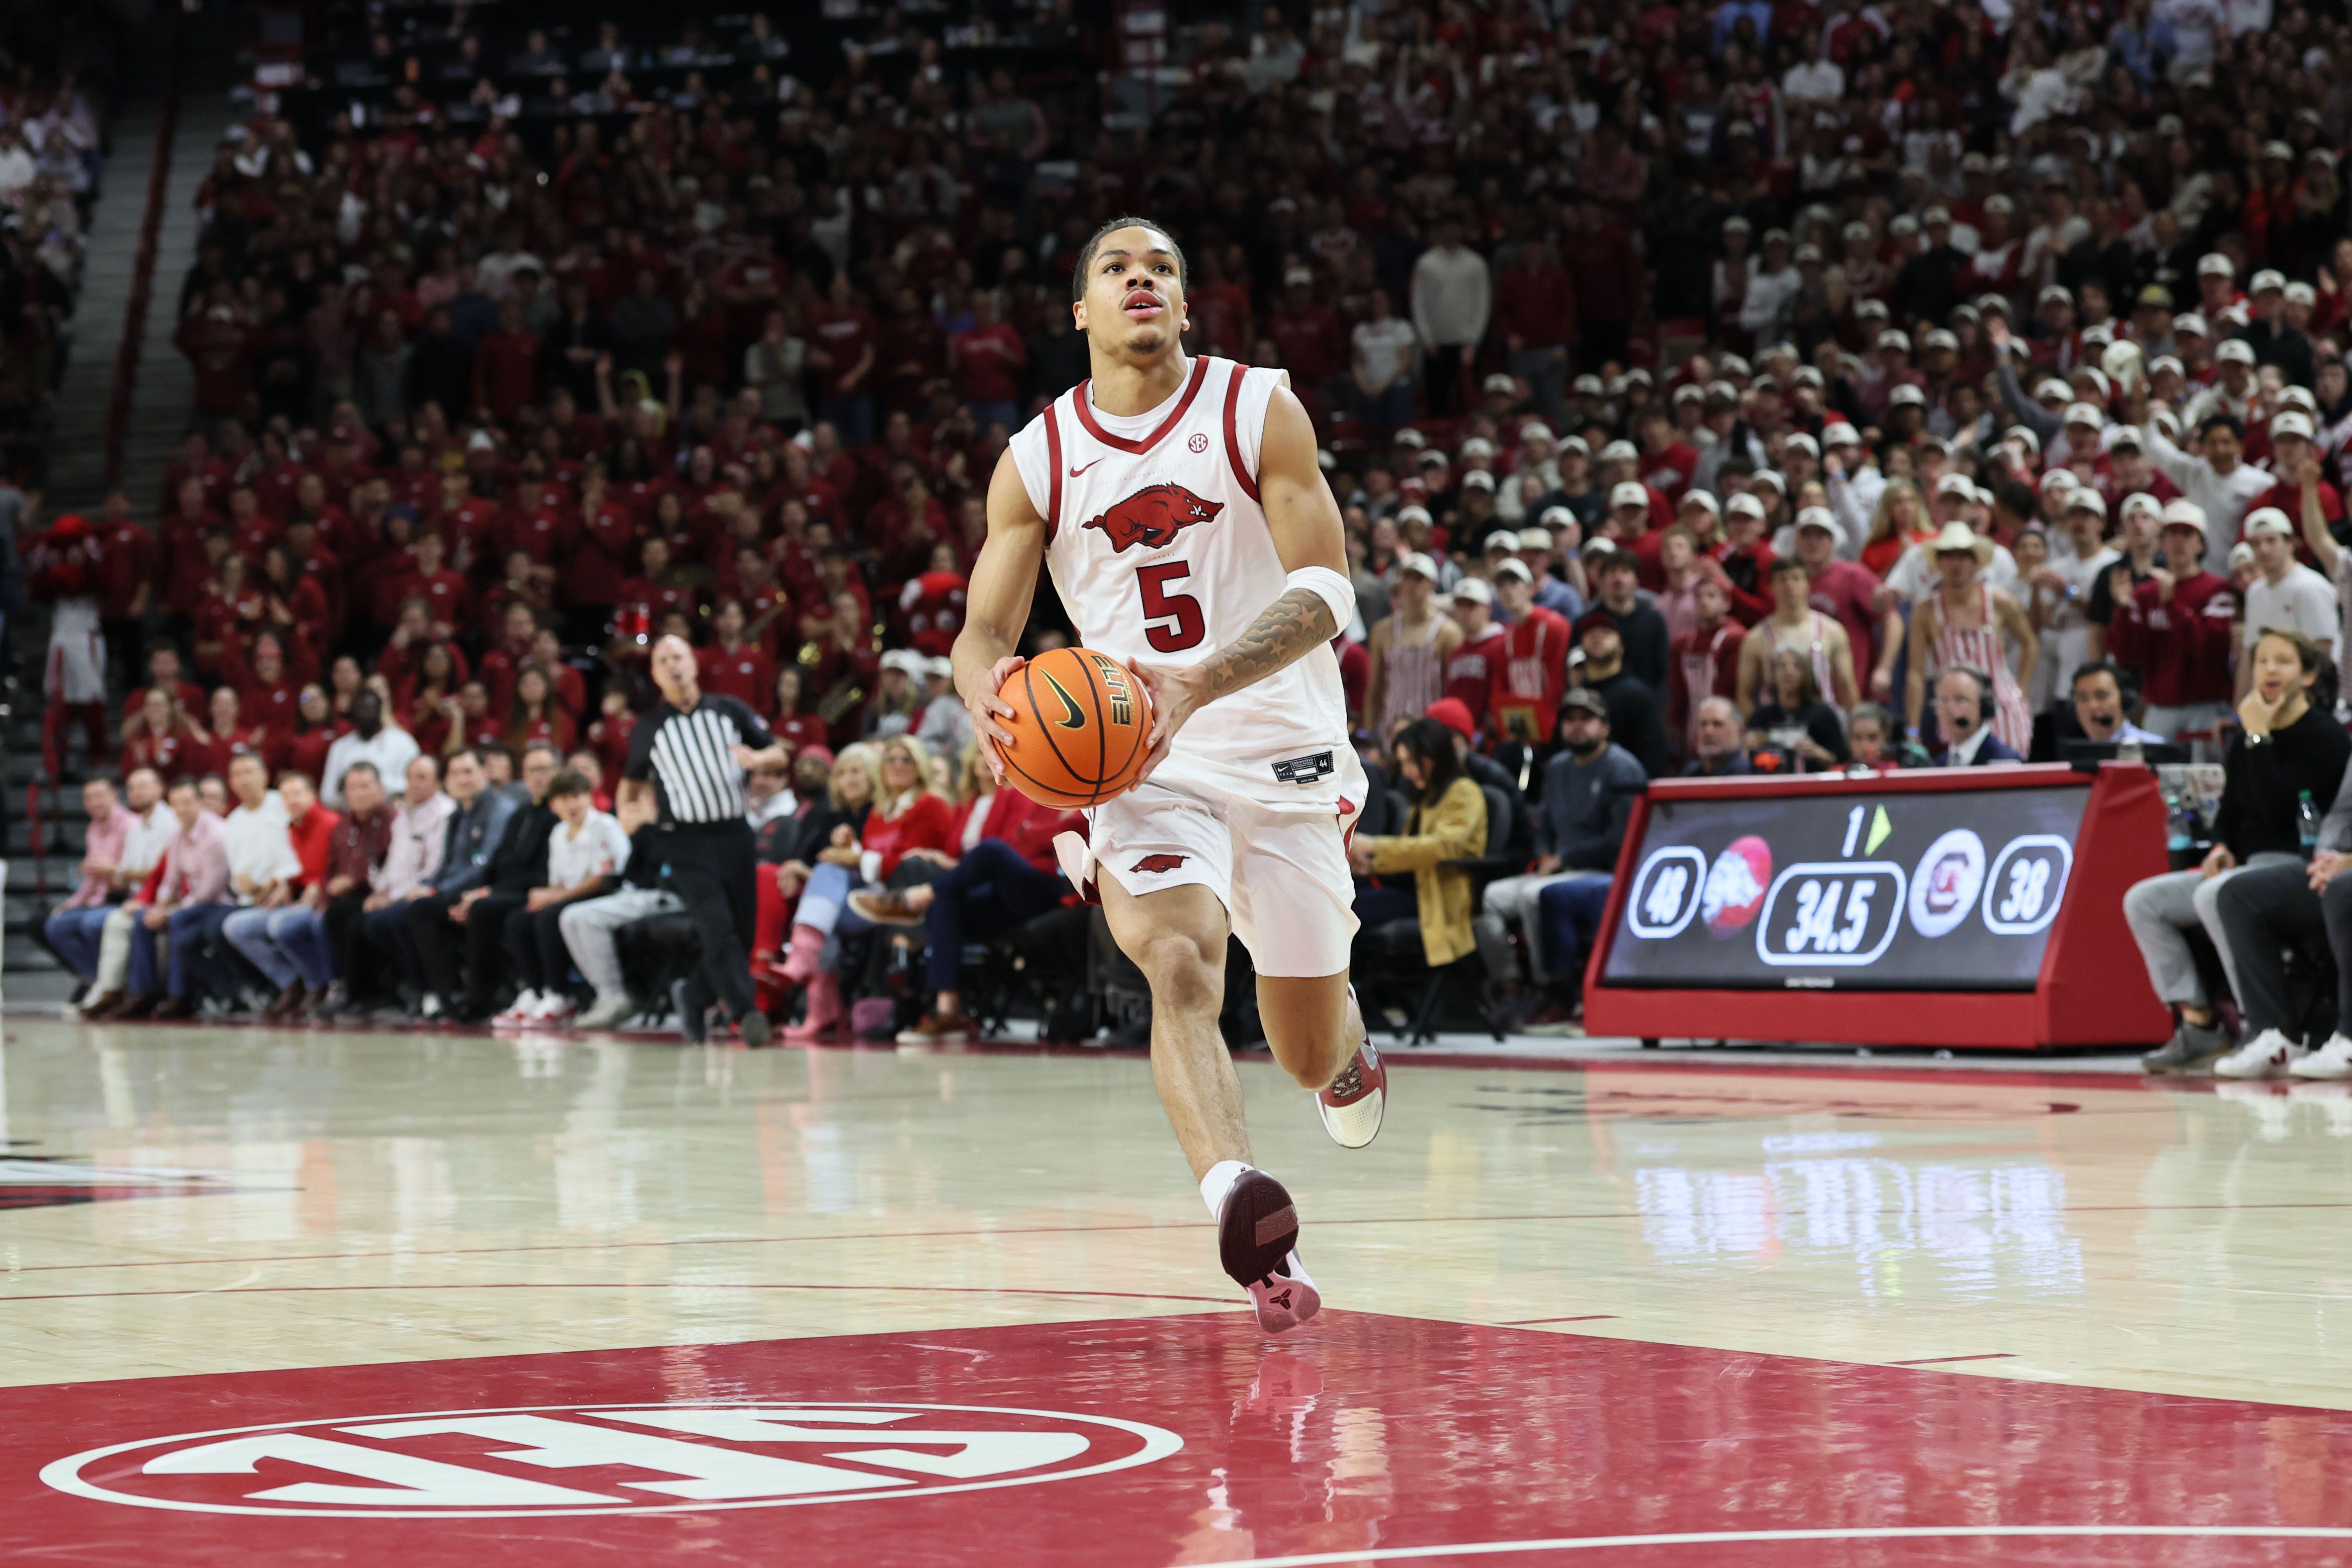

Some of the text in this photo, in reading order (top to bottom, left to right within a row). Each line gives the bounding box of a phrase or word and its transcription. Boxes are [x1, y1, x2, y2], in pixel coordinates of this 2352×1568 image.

[1189, 435, 1208, 452] SEC
[1135, 560, 1205, 653] 5
[1090, 655, 1131, 725] ELITE
[1319, 759, 1327, 768] 44
[1841, 804, 1865, 858] 1
[1645, 865, 1688, 924] 48
[1785, 878, 1877, 953] 34.5
[2000, 858, 2051, 922] 38
